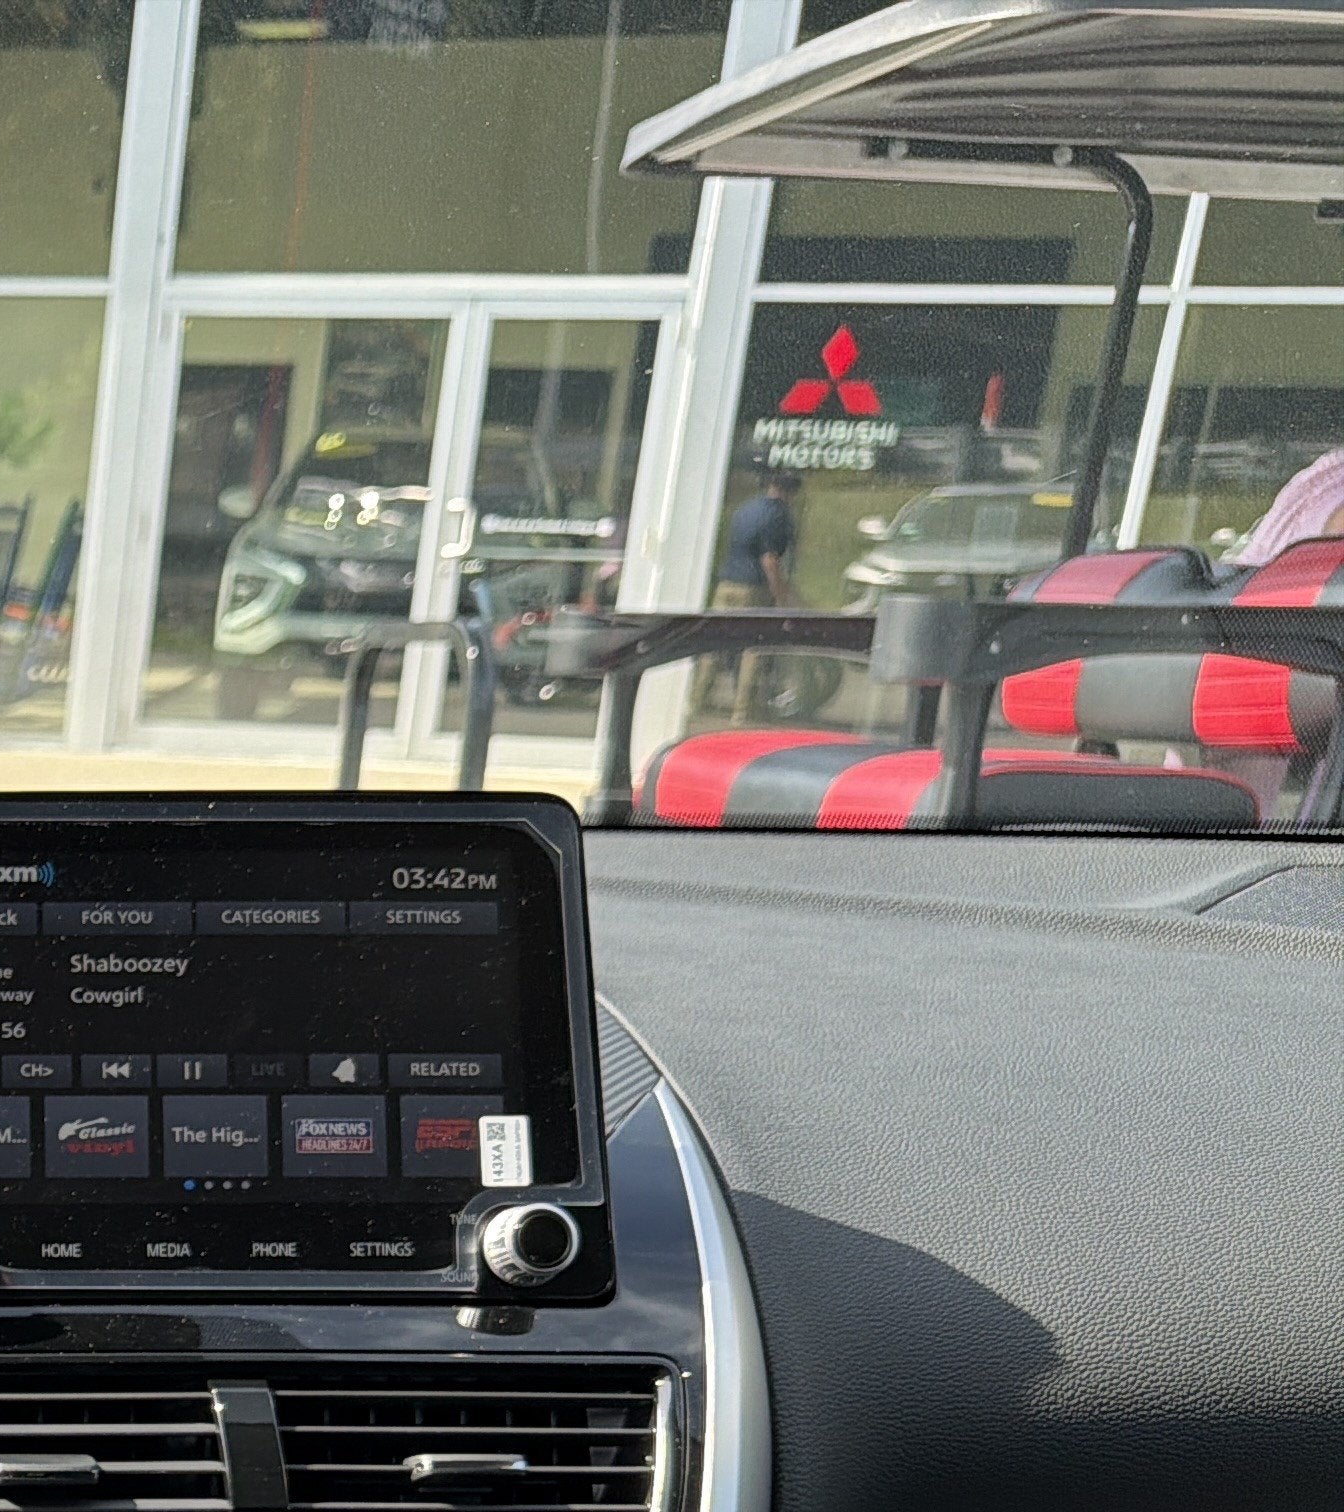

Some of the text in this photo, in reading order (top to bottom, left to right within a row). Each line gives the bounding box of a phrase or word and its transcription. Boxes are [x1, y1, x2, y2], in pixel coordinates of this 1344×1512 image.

[753, 418, 900, 447] MITSUBISHI
[768, 444, 875, 470] MOTORS
[81, 910, 153, 925] FOR YOU
[221, 909, 320, 924] CATEGORIES
[386, 909, 462, 924] SETTINGS
[70, 954, 190, 977] Shaboozey
[70, 985, 144, 1007] Cowgirl
[1, 1022, 26, 1039] 56
[251, 1062, 286, 1077] LIVE
[410, 1062, 480, 1077] RELATED
[171, 1127, 206, 1143] The
[300, 1122, 368, 1136] FOX NEWS
[41, 1243, 82, 1258] HOME
[146, 1243, 191, 1258] MEDIA
[252, 1243, 297, 1258] PHONE
[350, 1242, 413, 1257] SETTINGS
